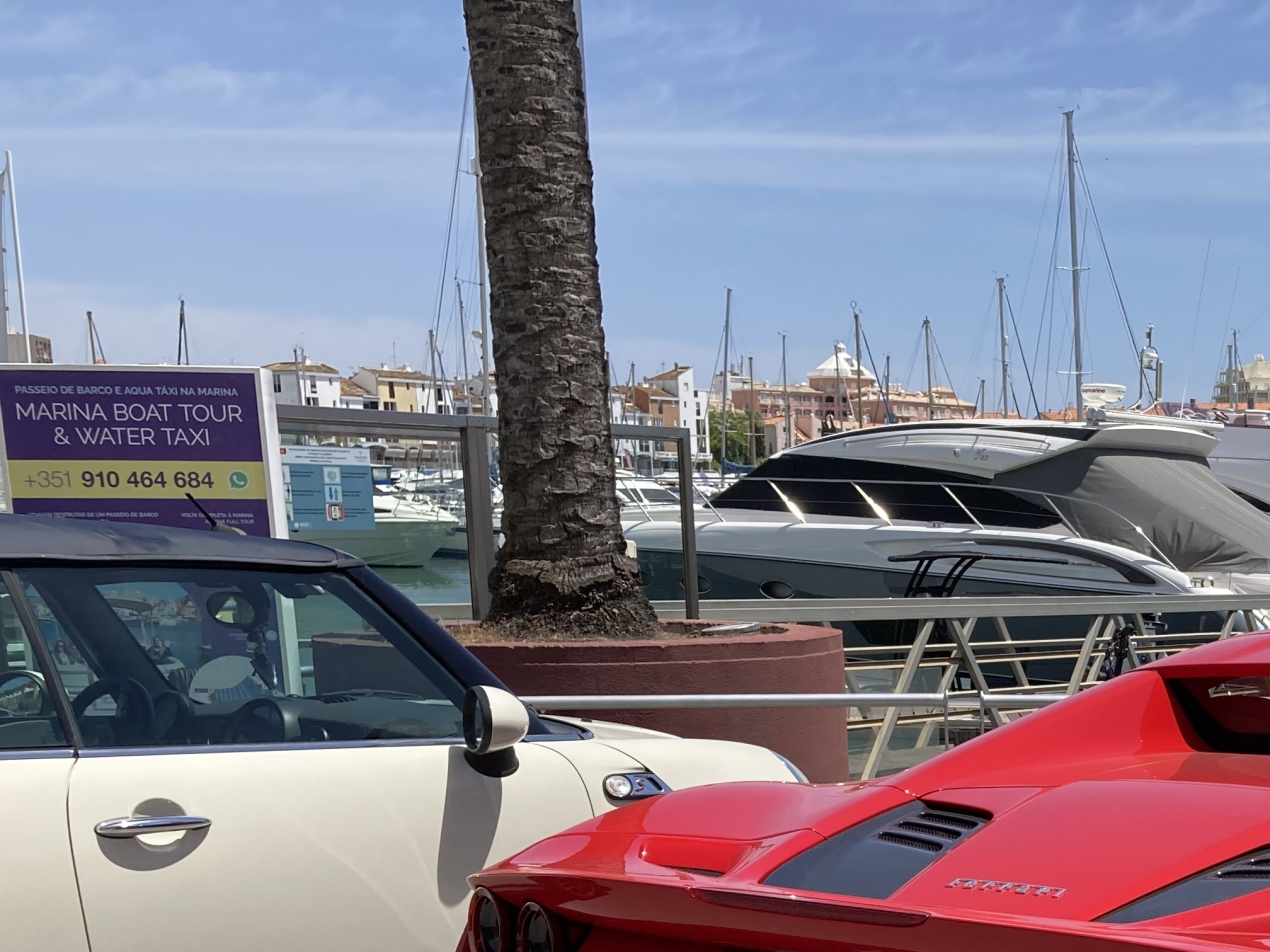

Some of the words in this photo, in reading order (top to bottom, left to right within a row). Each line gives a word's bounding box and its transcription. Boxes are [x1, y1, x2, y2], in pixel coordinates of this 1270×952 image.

[14, 385, 58, 394] PASSEIO
[60, 385, 74, 394] DE
[76, 386, 112, 395] BARCO
[115, 386, 122, 395] E
[124, 387, 154, 395] AQUA
[180, 387, 196, 396] NA
[197, 388, 238, 396] MARINA
[15, 402, 108, 421] MARINA
[113, 403, 172, 422] BOAT
[178, 404, 243, 422] TOUR
[54, 427, 71, 445] &
[75, 427, 156, 446] WATER
[160, 428, 210, 446] TAXI
[23, 470, 72, 488] +351
[81, 471, 120, 488] 910
[126, 471, 167, 488] 464
[173, 471, 215, 489] 684
